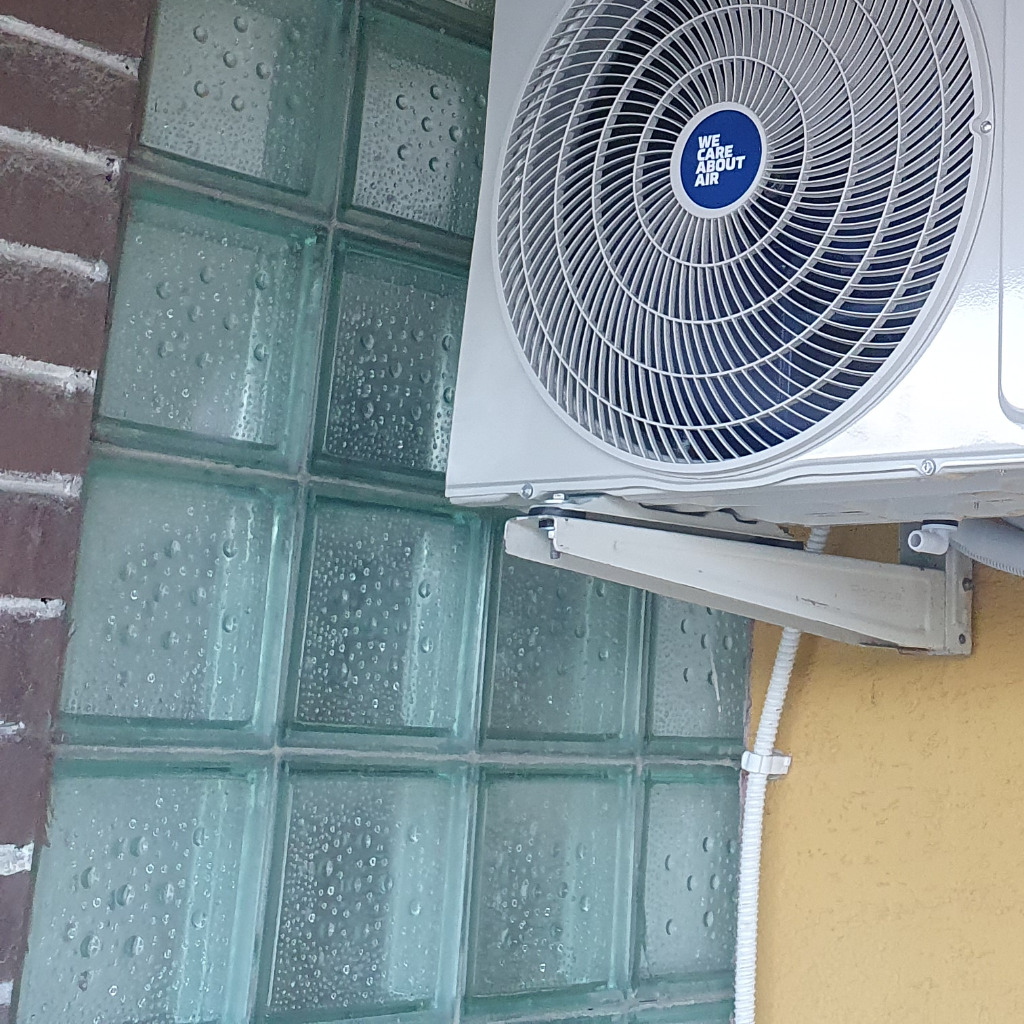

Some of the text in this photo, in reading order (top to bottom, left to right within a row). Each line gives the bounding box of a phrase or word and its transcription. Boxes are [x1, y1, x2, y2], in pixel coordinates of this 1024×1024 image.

[698, 133, 721, 149] WE
[697, 144, 734, 161] CARE
[695, 155, 746, 174] ABOUT
[694, 172, 719, 187] AIR
